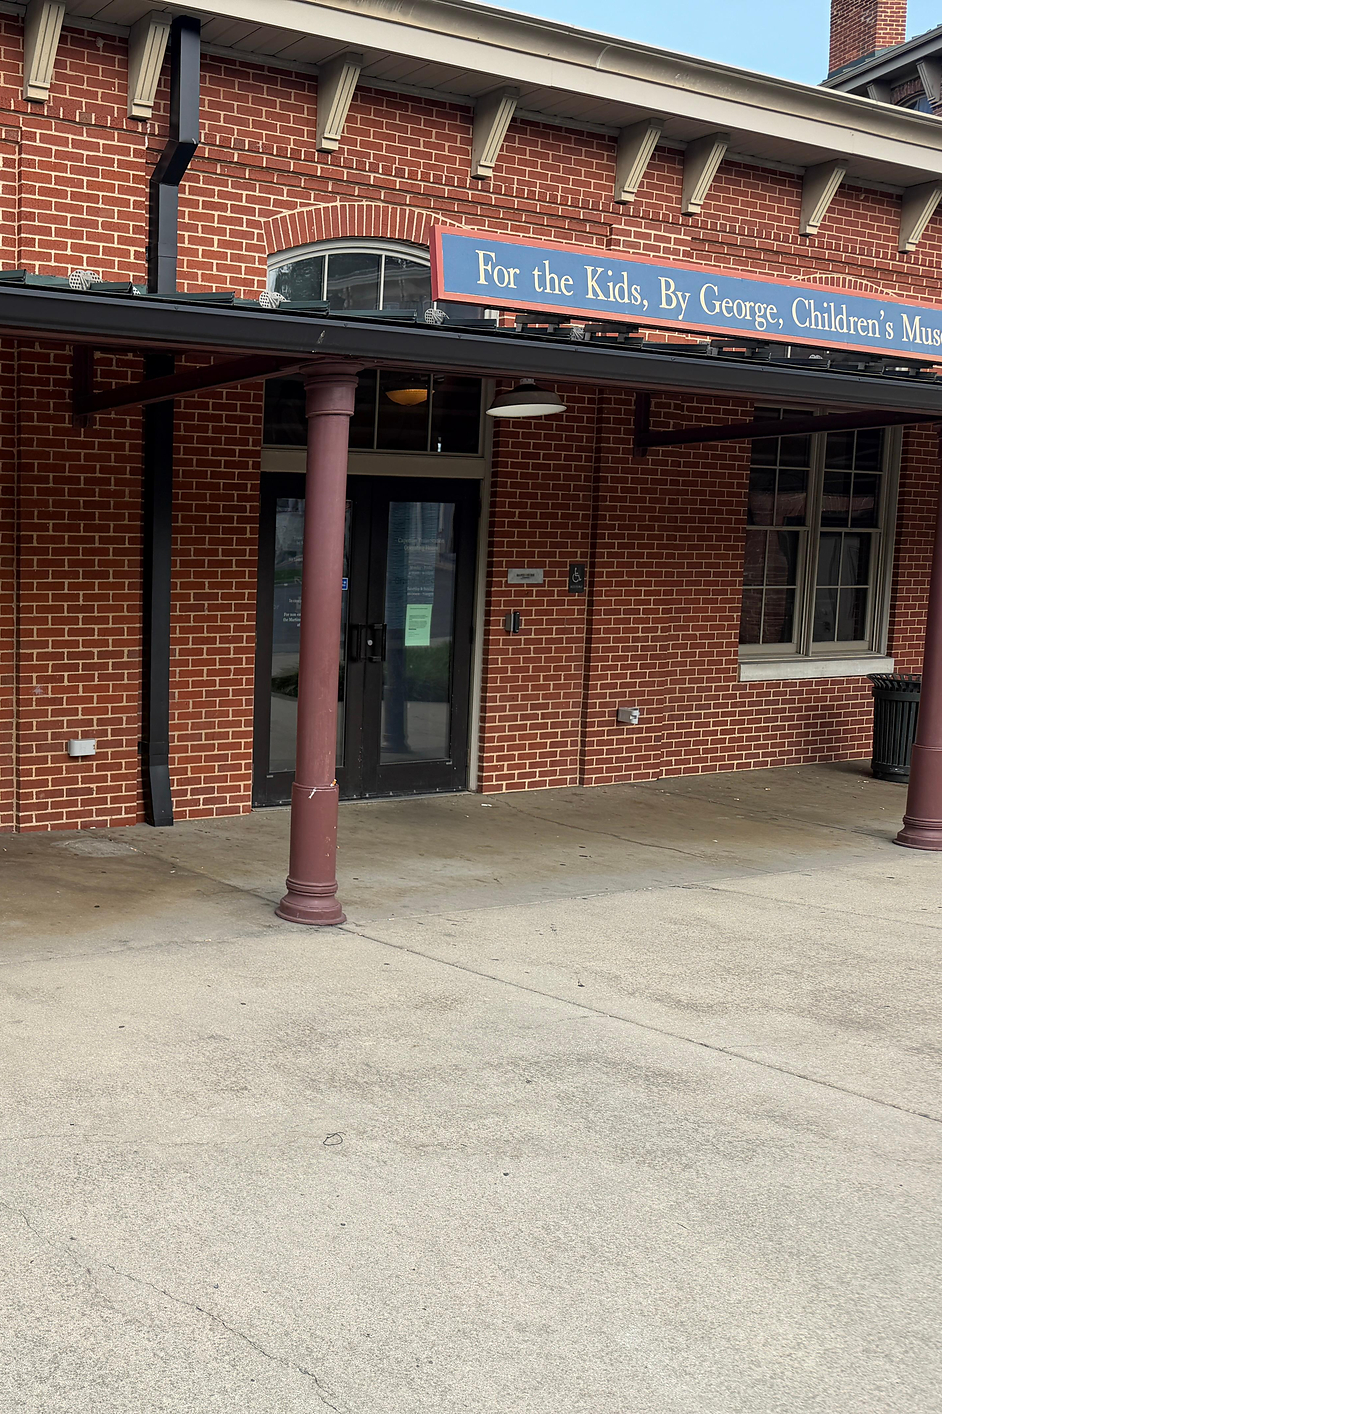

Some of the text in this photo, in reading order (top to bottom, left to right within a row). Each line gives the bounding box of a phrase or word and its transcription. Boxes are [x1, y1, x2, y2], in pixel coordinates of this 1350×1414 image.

[475, 249, 520, 289] For
[532, 260, 574, 296] the
[584, 265, 649, 311] Kids,
[658, 276, 691, 320] By
[700, 283, 784, 331] George,
[792, 297, 894, 340] Children’s
